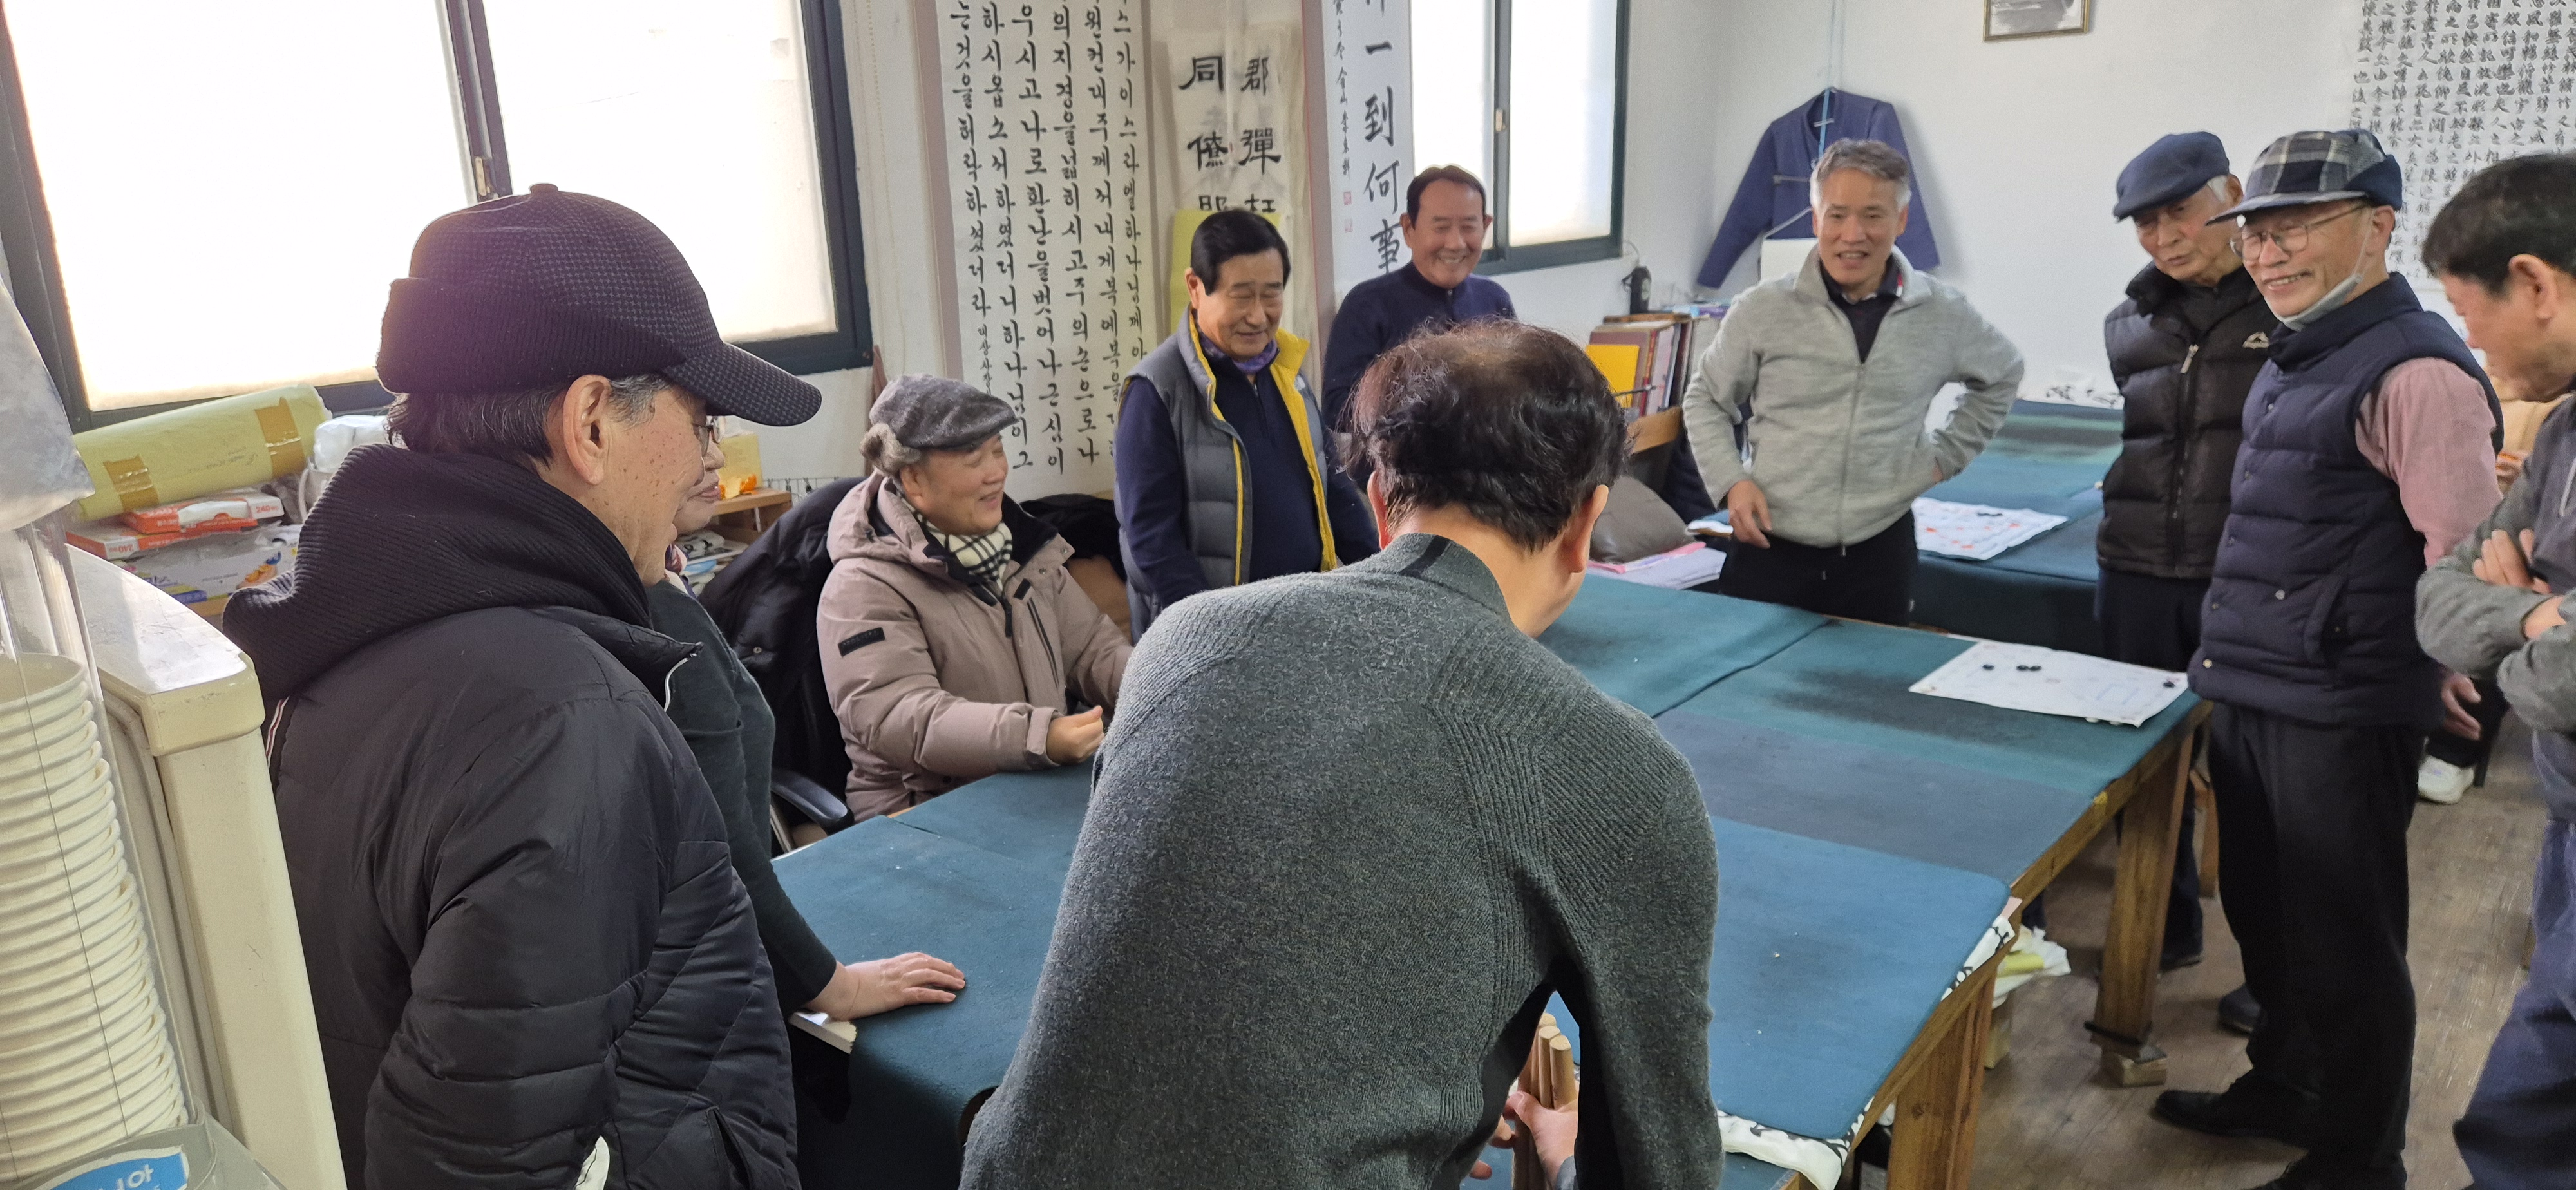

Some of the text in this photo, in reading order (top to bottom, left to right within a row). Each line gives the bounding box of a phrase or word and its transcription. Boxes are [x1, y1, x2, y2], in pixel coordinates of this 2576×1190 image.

[1113, 0, 1148, 362] 스가이스라엘하나님께아
[1363, 0, 1404, 275] 一到何事
